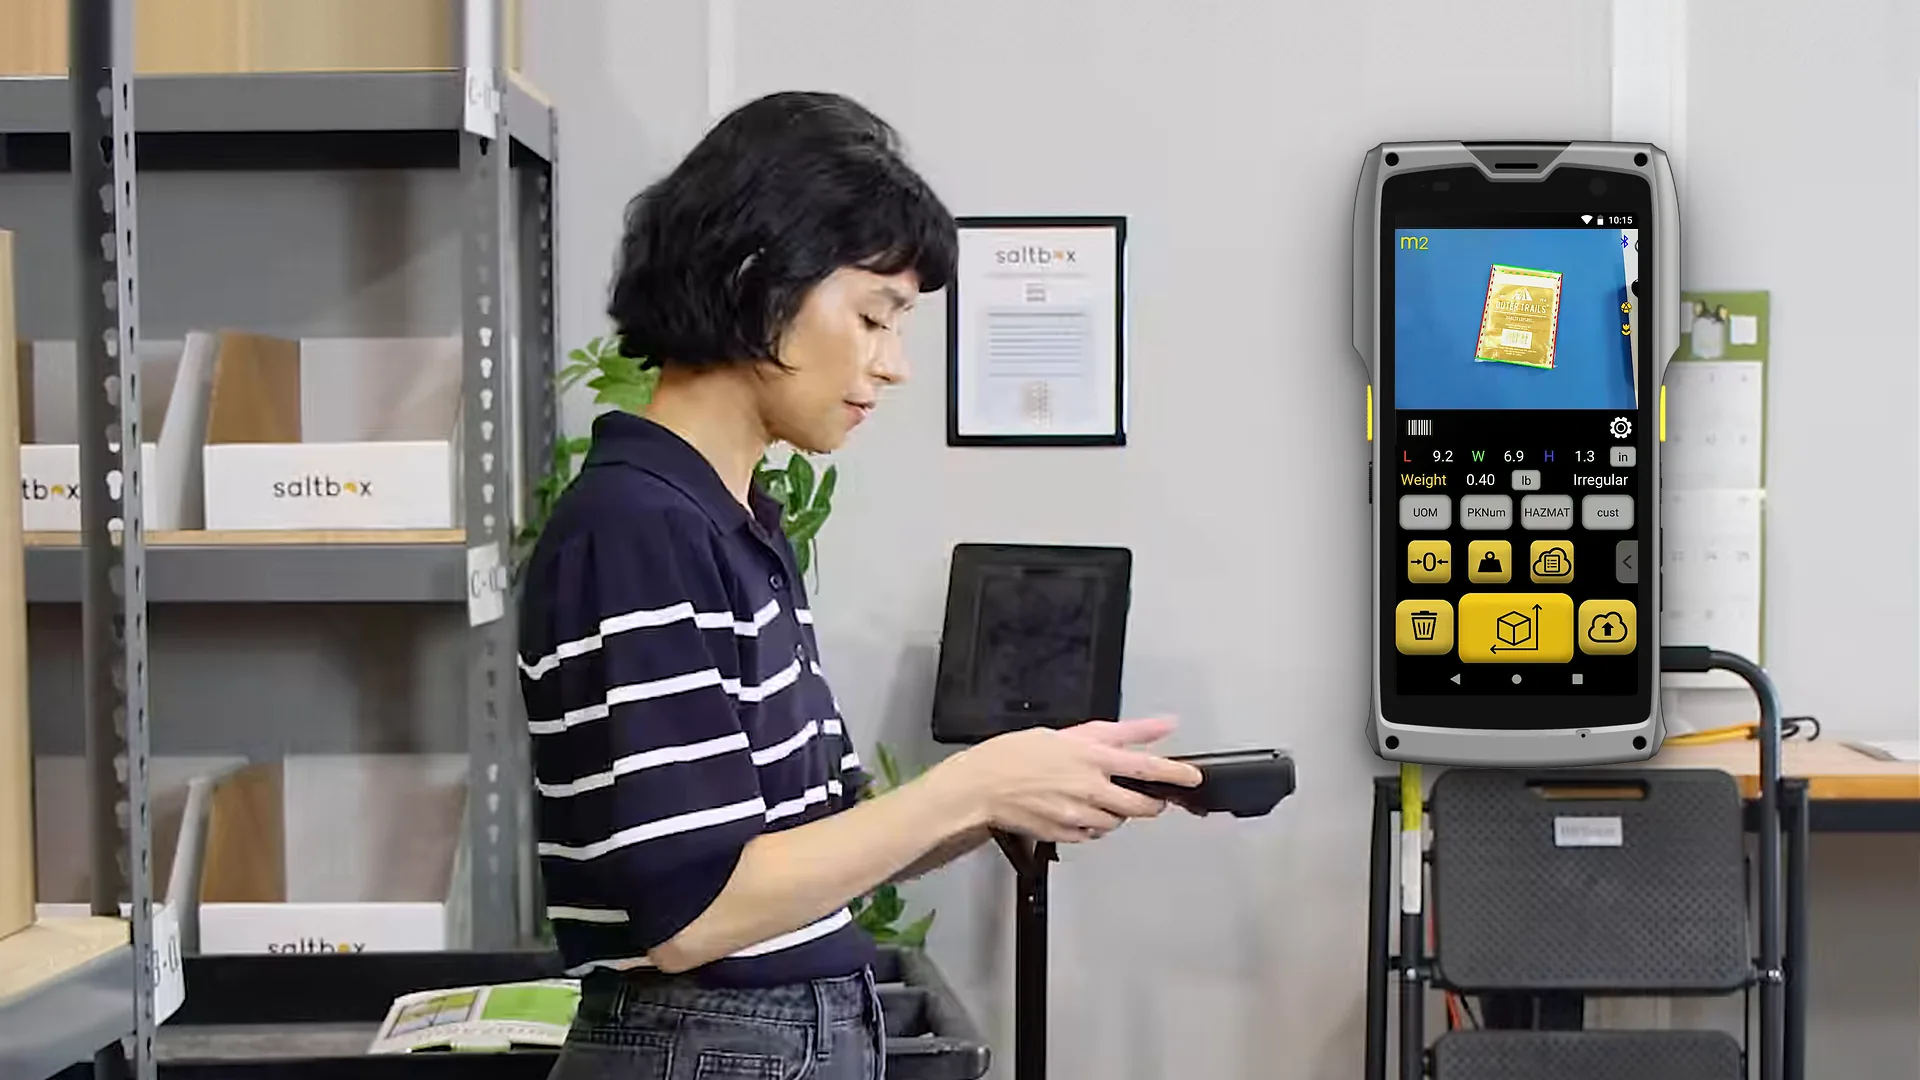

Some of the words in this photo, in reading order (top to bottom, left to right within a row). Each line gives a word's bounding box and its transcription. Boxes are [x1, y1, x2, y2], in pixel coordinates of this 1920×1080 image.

[1608, 216, 1633, 225] 10:15
[1400, 236, 1429, 251] m2
[1495, 299, 1519, 312] OUTER
[1520, 302, 1547, 314] TRAILS
[1404, 450, 1412, 463] L
[1433, 450, 1454, 463] 9.2
[1472, 450, 1485, 463] W
[1504, 450, 1524, 463] 6.9
[1544, 450, 1554, 463] H
[1575, 450, 1595, 463] 1.3
[1618, 452, 1628, 462] in
[273, 476, 371, 498] saltbox
[1401, 474, 1447, 489] Weight
[1466, 474, 1496, 486] 0.40
[1521, 475, 1532, 486] lb
[1573, 474, 1629, 489] Irregular
[1413, 507, 1438, 518] UOM
[1467, 507, 1506, 518] PKNum
[1524, 507, 1571, 518] HAZMAT
[1597, 508, 1619, 518] cust
